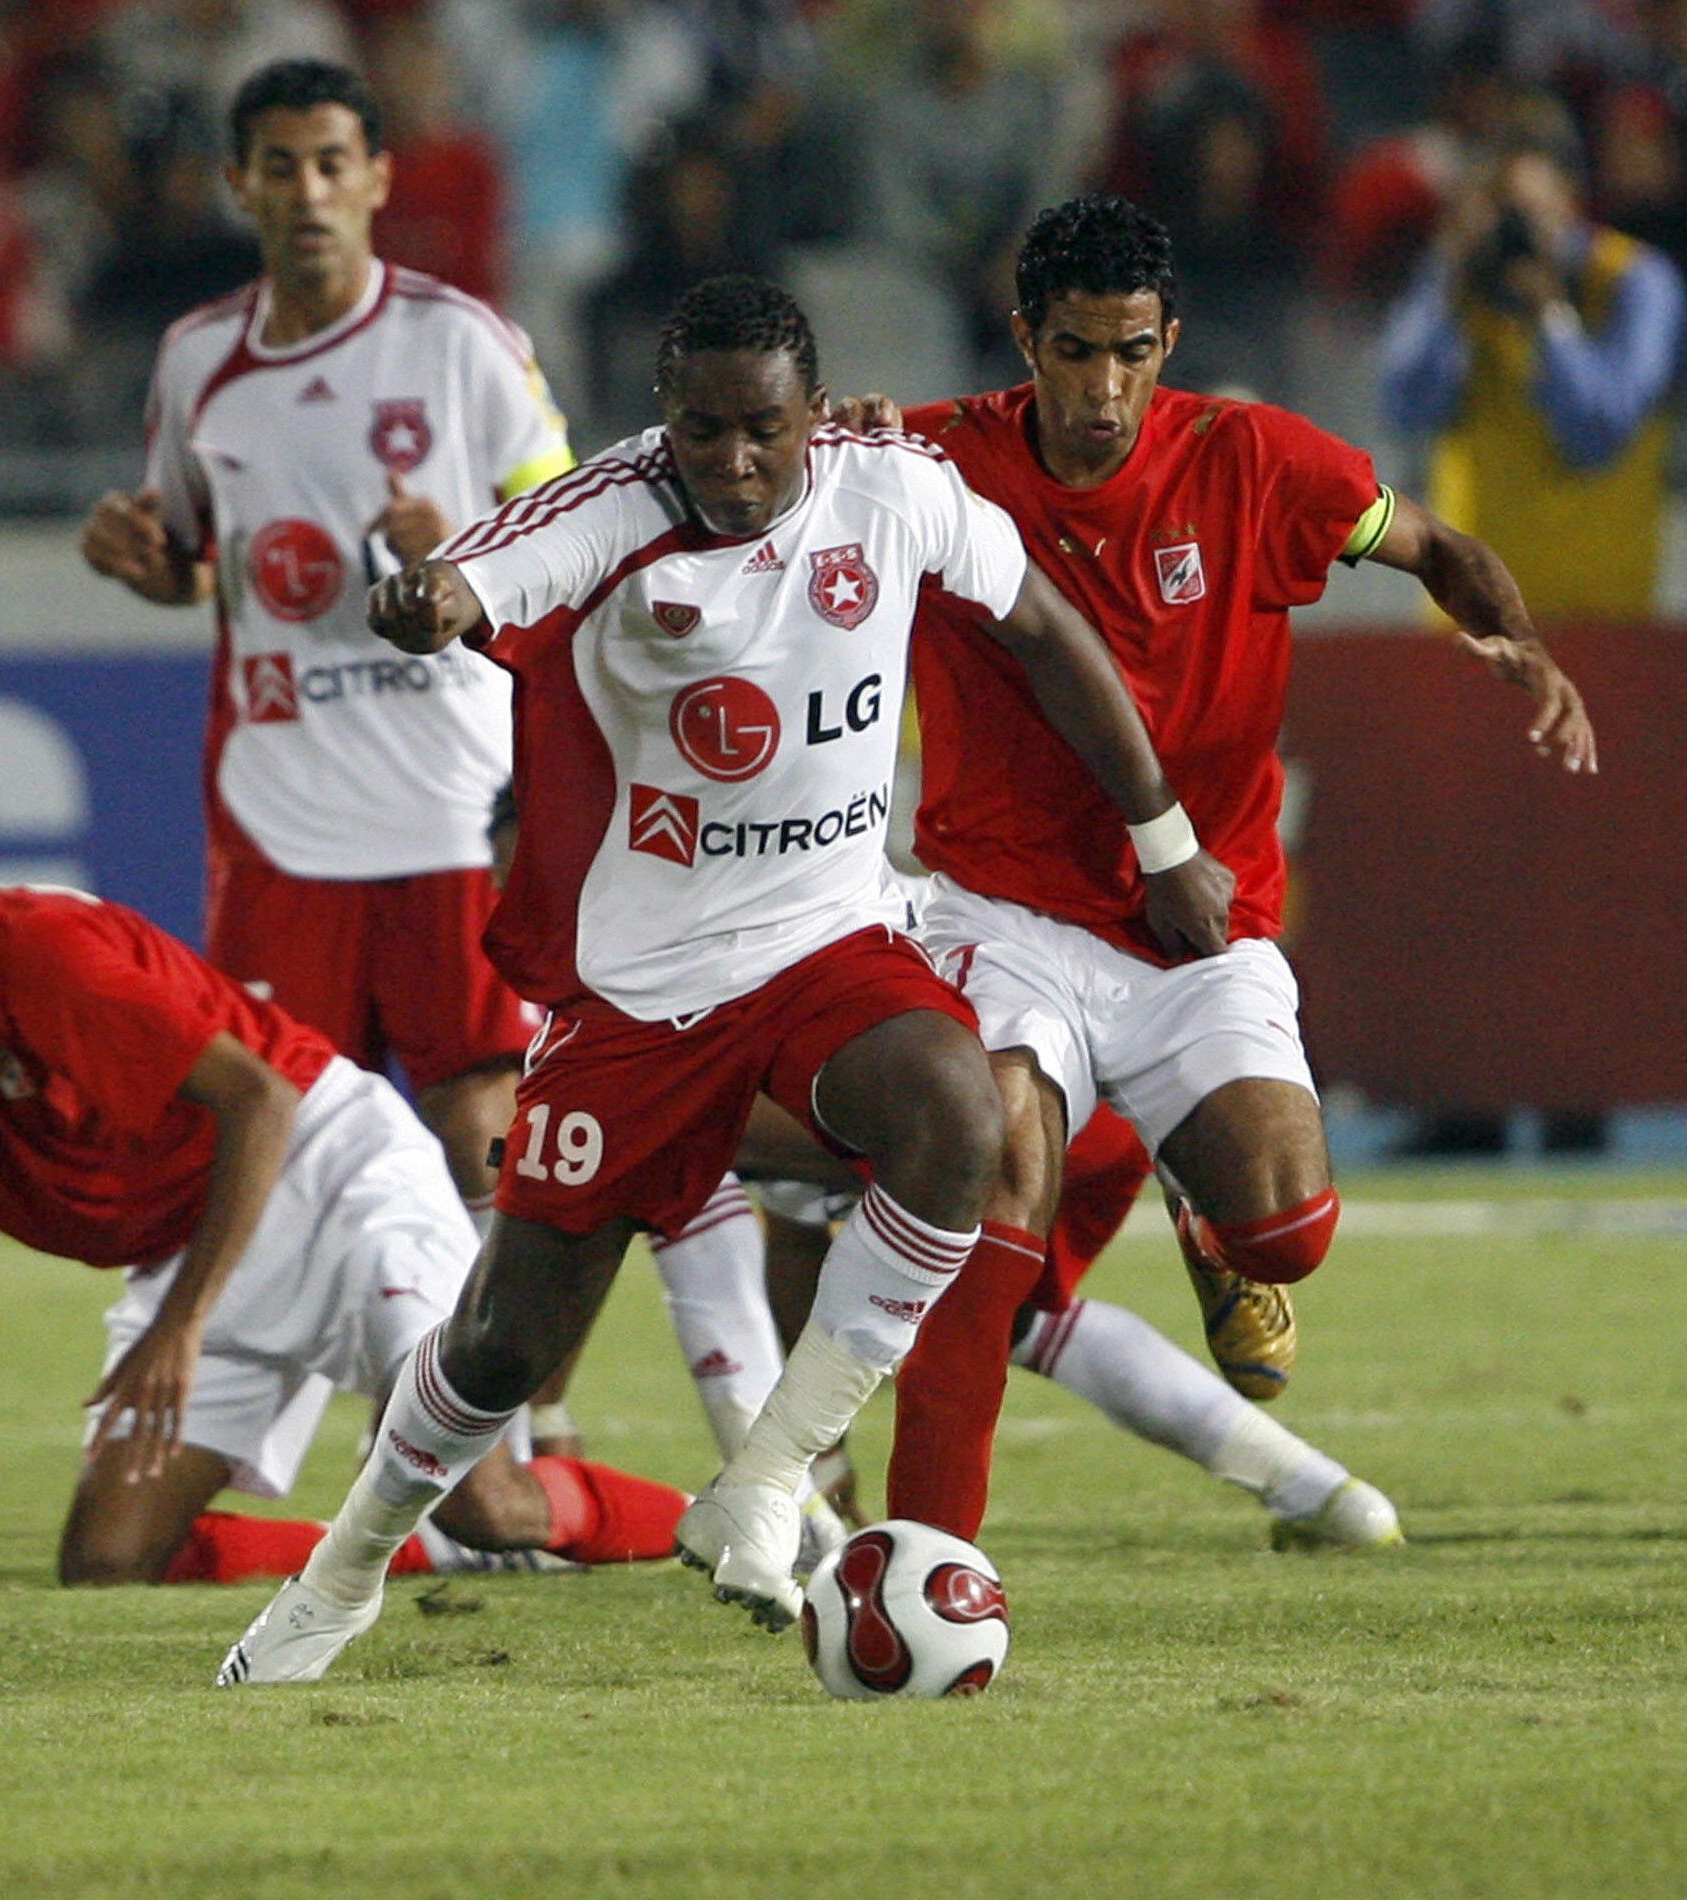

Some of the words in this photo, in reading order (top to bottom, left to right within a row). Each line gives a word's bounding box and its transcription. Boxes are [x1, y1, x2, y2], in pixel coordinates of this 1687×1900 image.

[806, 673, 882, 746] LG
[699, 783, 888, 858] CITROËN
[515, 1103, 604, 1187] 19
